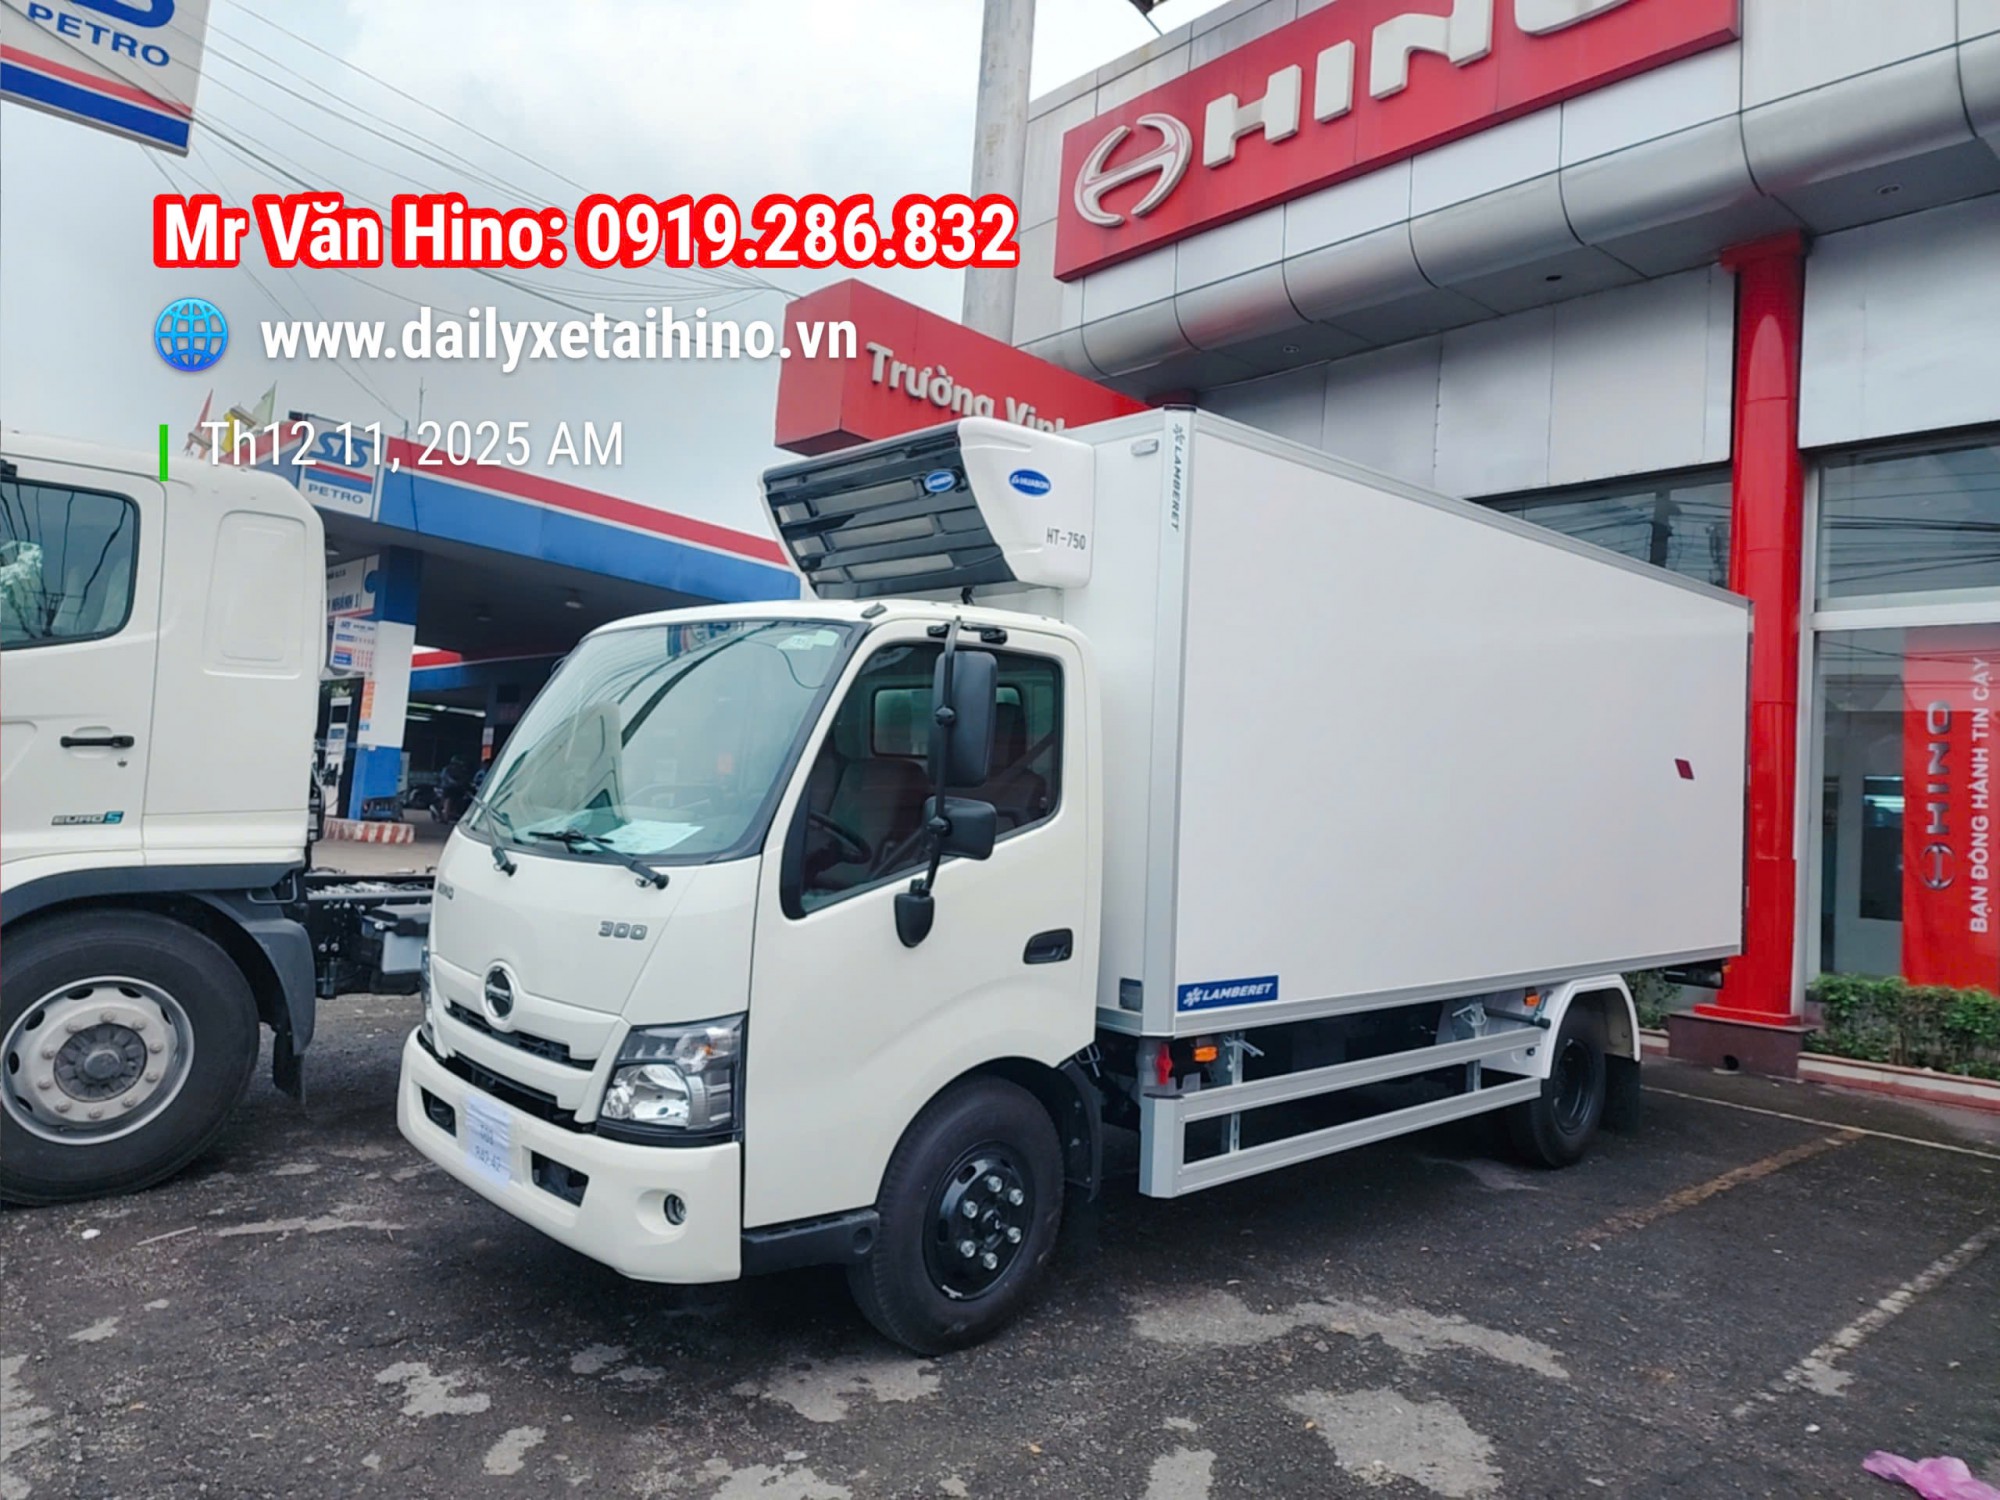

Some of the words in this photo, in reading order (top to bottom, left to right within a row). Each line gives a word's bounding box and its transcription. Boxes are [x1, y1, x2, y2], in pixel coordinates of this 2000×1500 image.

[28, 2, 170, 66] PETRO
[1203, 0, 1625, 168] HIN
[307, 482, 364, 505] PETRO
[1171, 445, 1183, 533] LAMBERET
[1046, 527, 1087, 550] HT-750
[1971, 708, 1989, 742] TIN
[1927, 700, 1951, 835] HINO
[1967, 747, 1989, 809] HÀNH
[598, 920, 648, 941] 300
[1969, 886, 1992, 933] BẠN
[1202, 982, 1274, 1001] LAMBERET
